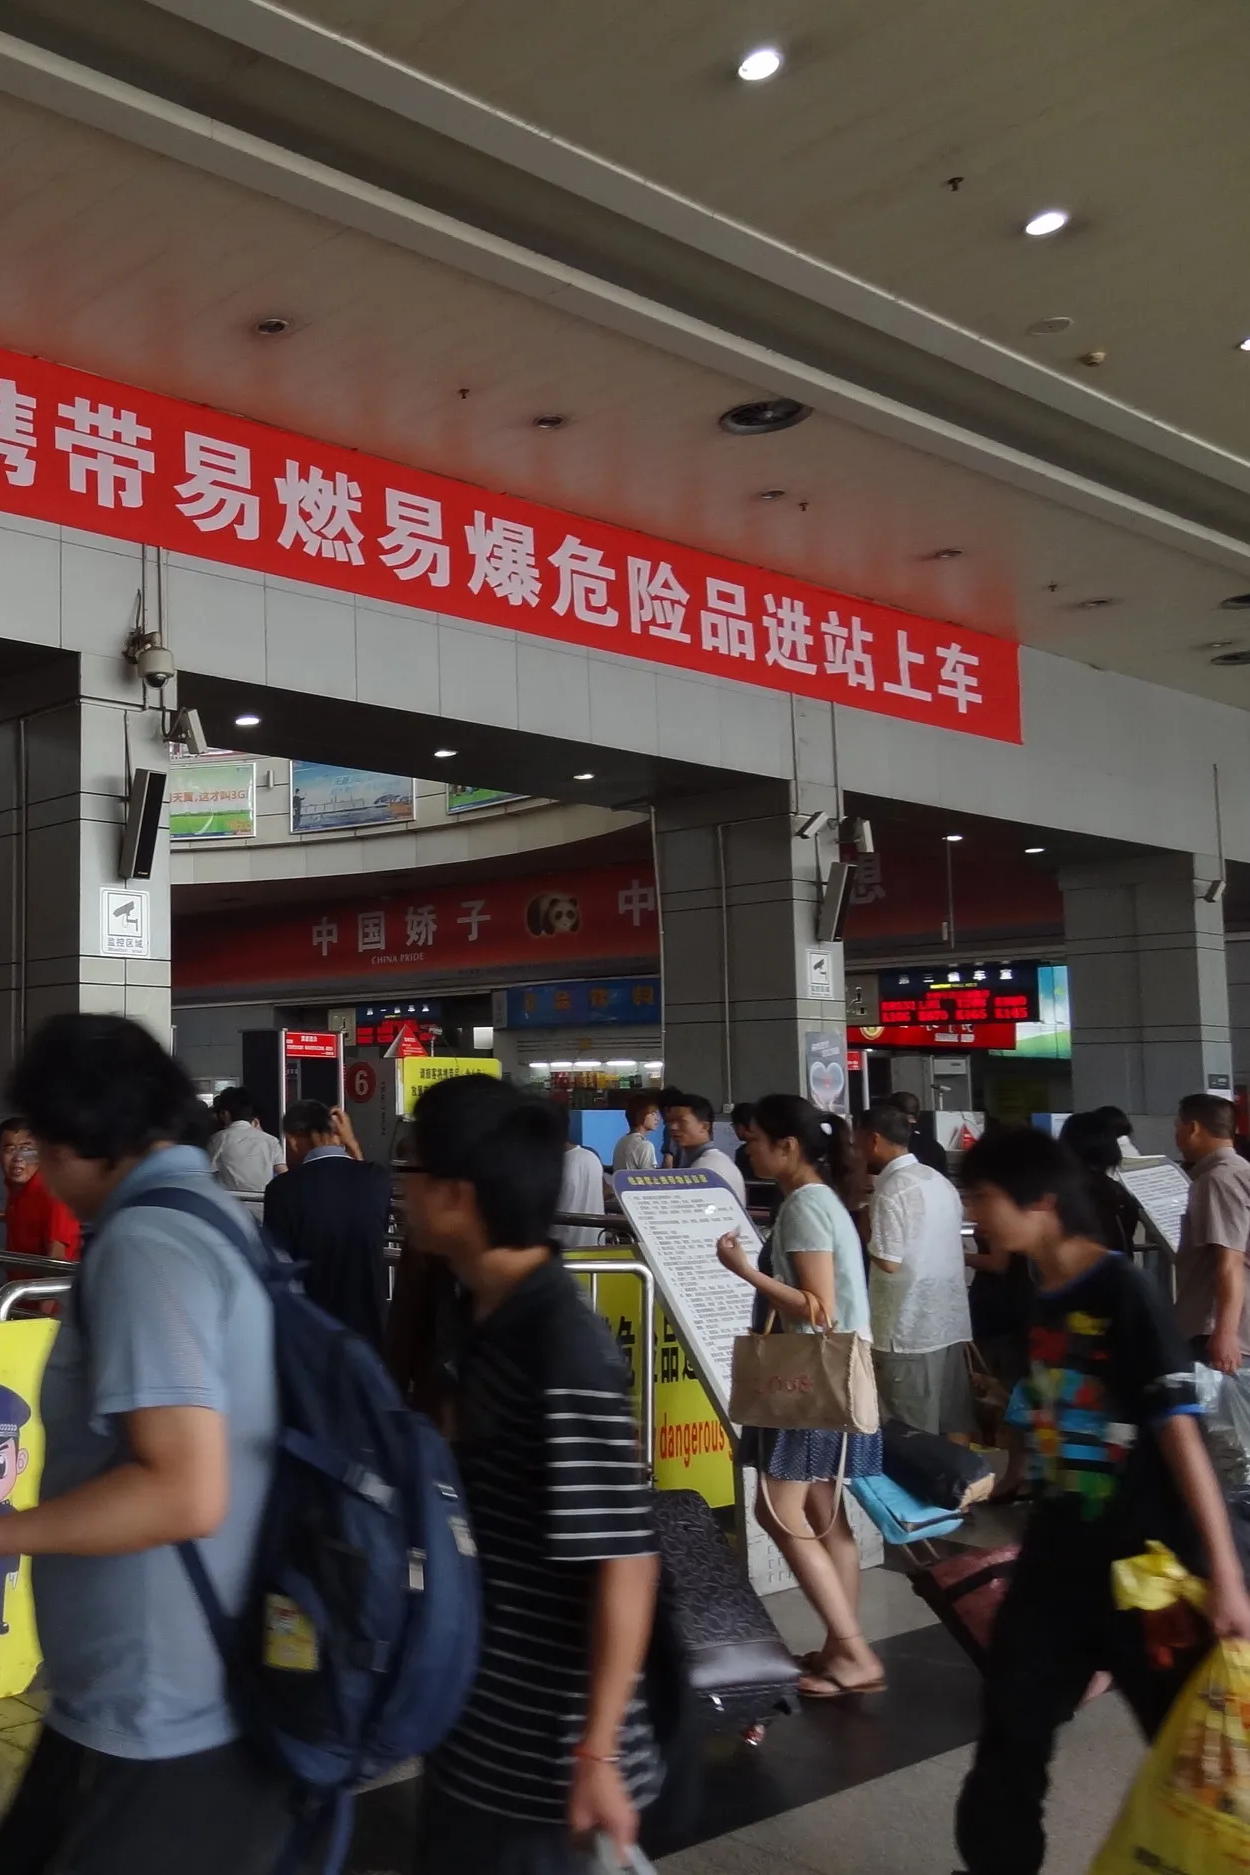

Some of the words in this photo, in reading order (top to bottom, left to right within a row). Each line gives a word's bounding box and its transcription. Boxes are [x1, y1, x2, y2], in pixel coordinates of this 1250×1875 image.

[617, 878, 655, 927] 中
[312, 899, 491, 957] 中国娇子
[370, 954, 398, 965] CHINA
[400, 951, 426, 963] PRIDE
[358, 1069, 370, 1097] 6
[660, 1412, 725, 1468] dangerous
